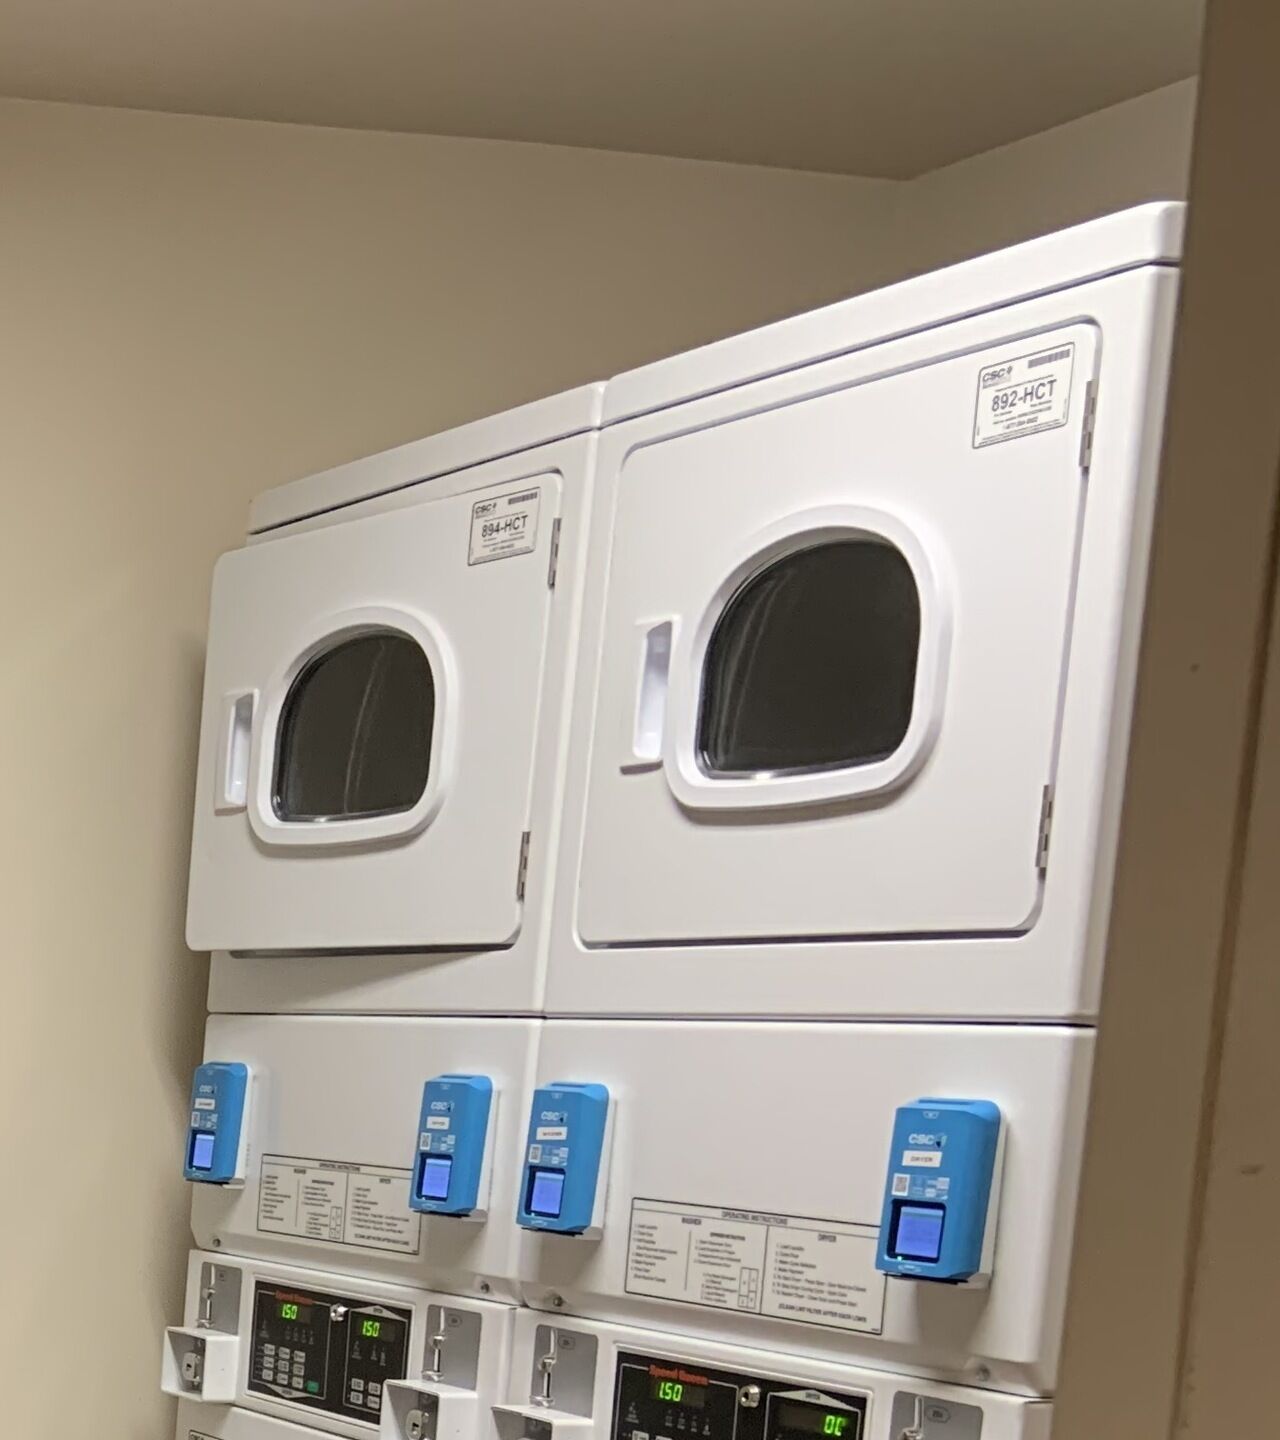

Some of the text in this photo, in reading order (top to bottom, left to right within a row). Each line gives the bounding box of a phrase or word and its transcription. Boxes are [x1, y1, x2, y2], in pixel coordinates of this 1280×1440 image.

[982, 368, 1006, 382] CSC
[991, 379, 1057, 412] 892-HCT
[481, 515, 528, 538] 894-HCT
[908, 1133, 935, 1145] CSC
